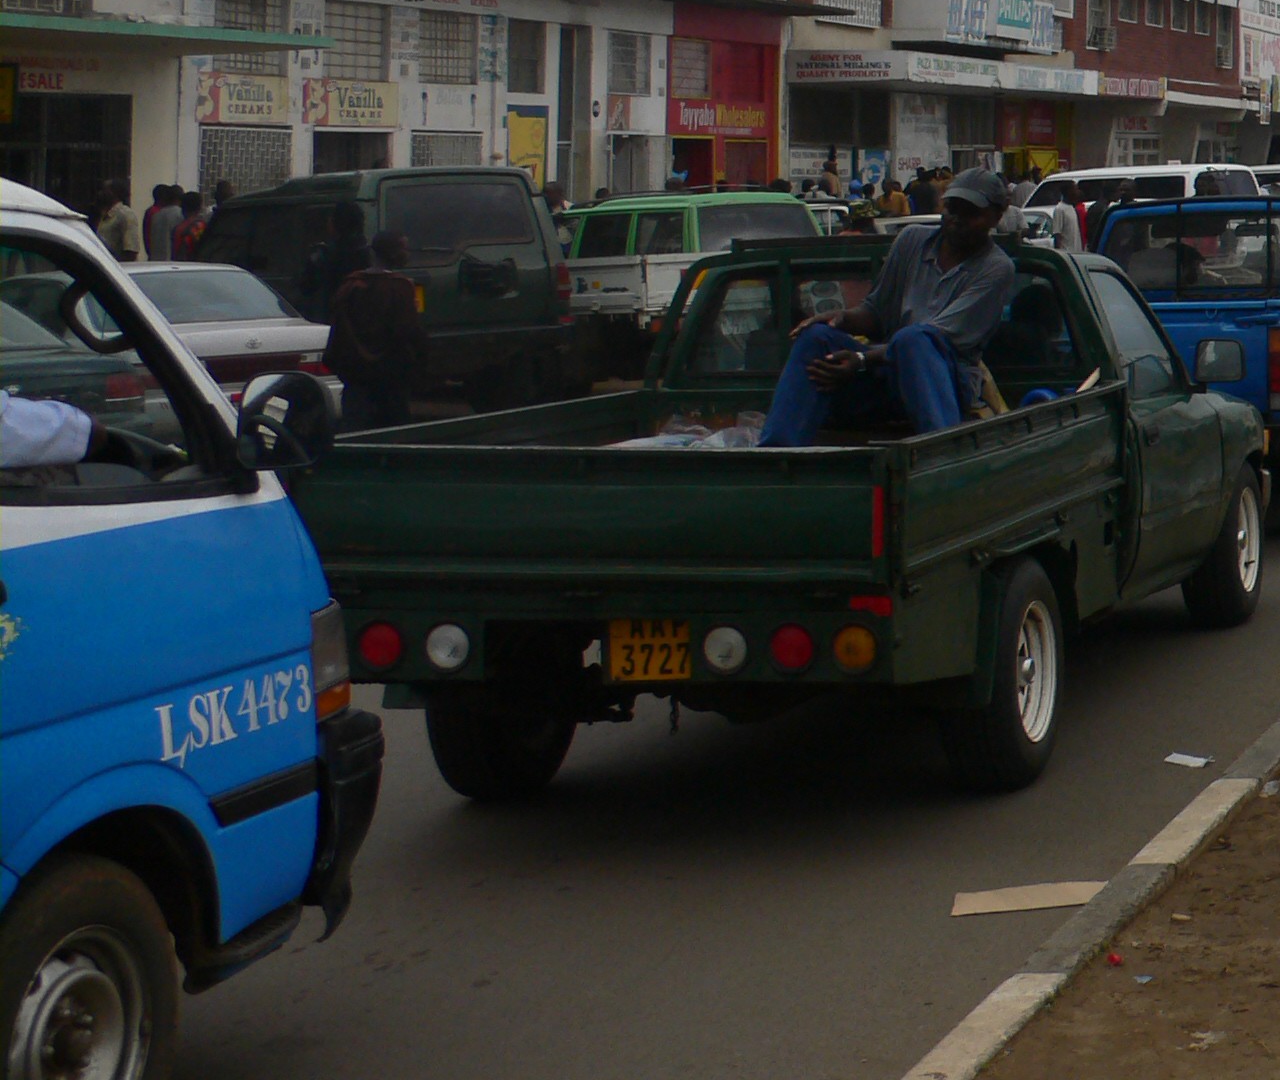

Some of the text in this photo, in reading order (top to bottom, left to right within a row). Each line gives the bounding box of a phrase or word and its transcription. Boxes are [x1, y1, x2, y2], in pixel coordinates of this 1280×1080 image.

[843, 54, 863, 62] FOR
[20, 73, 64, 90] ESALE
[796, 70, 836, 78] QUALITY
[227, 84, 274, 103] Vanilla
[337, 86, 385, 110] Vanilla
[228, 104, 273, 116] CREAMS
[339, 108, 382, 119] CREAMS
[680, 102, 766, 131] Tayyaba Wholesalers
[622, 643, 690, 675] 3727
[154, 664, 312, 768] LSK 4473
